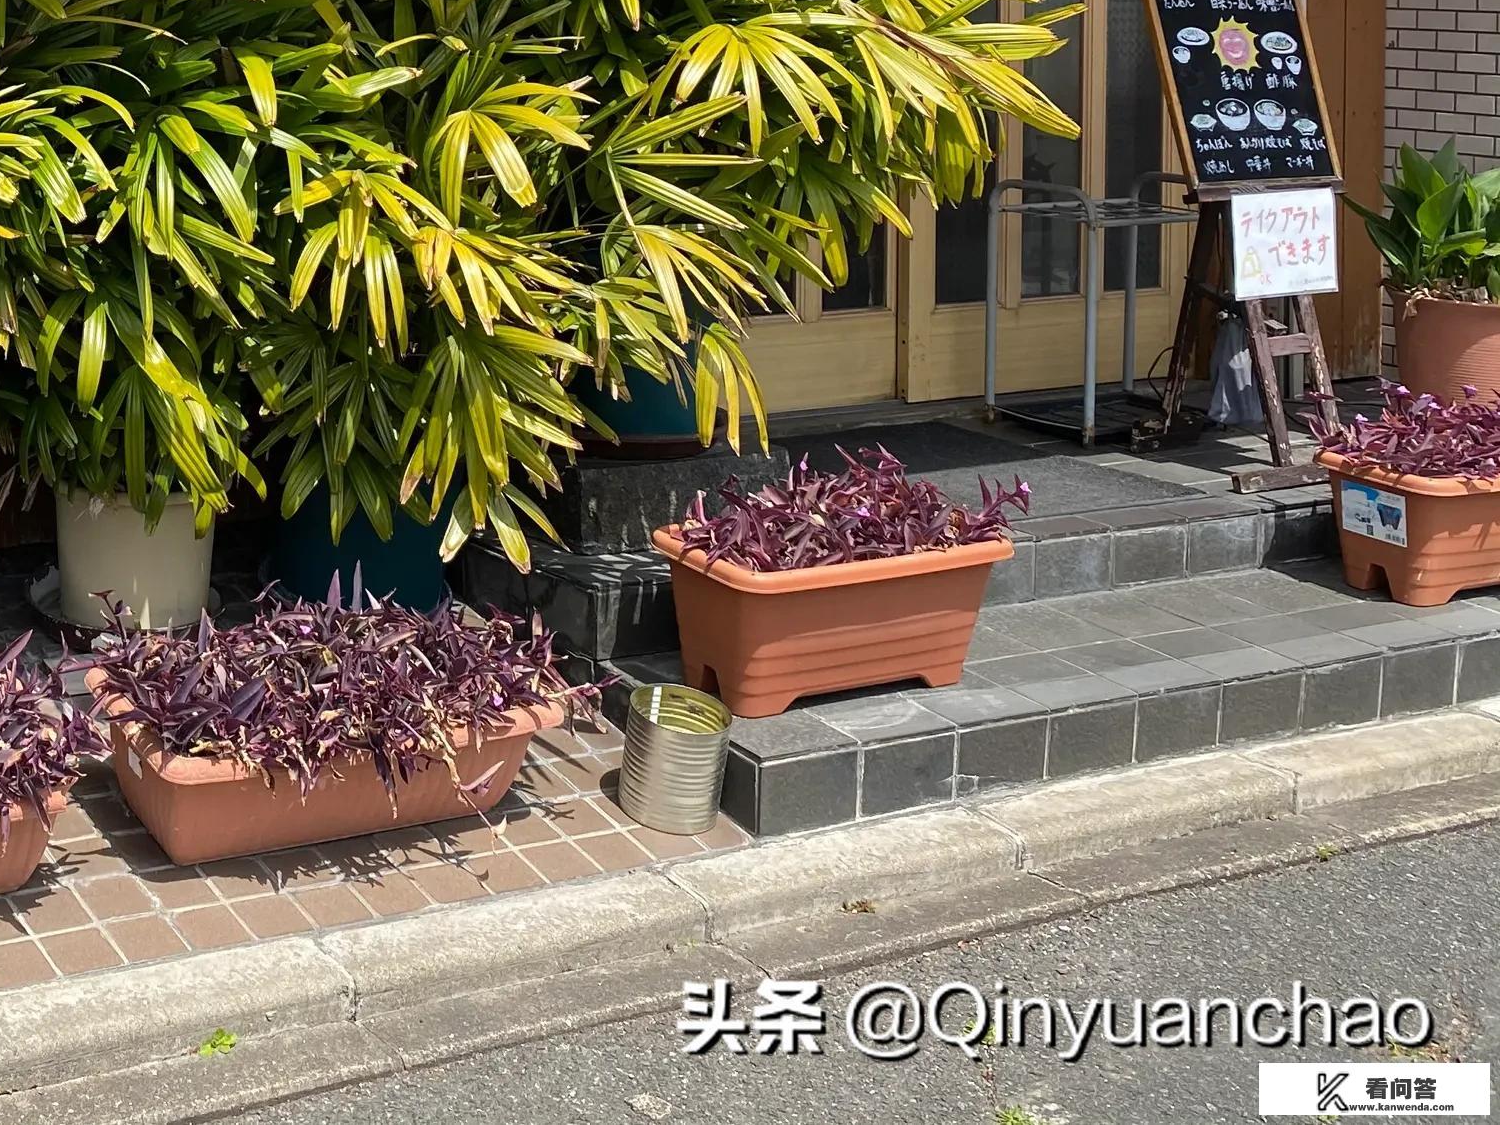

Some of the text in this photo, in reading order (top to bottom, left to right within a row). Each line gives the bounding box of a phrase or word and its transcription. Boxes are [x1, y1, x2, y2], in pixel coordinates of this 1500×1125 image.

[1221, 71, 1298, 91] 唐揚げ 酢豚
[1241, 206, 1320, 238] テイクアウト
[1268, 234, 1331, 267] できます
